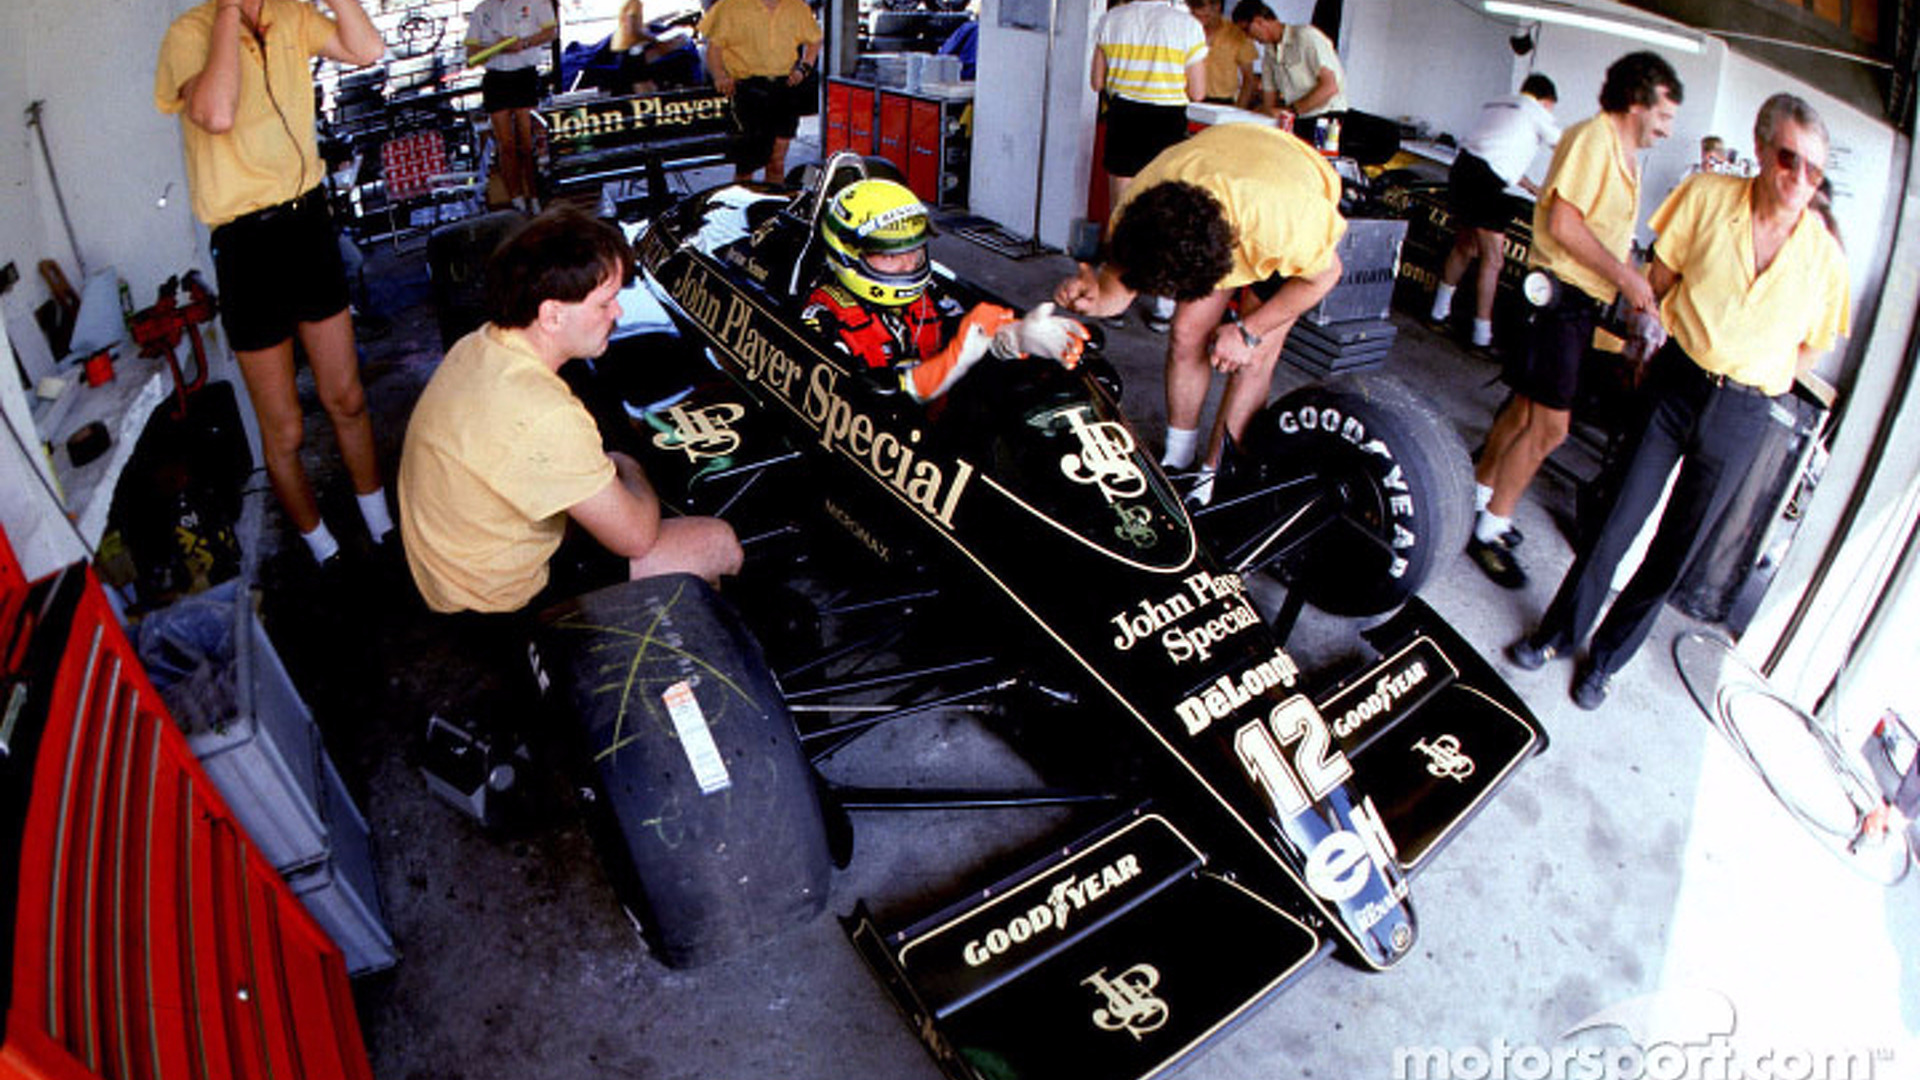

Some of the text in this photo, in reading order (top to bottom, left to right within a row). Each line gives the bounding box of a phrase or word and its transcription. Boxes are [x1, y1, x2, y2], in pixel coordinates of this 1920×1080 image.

[550, 97, 731, 141] John Player
[672, 260, 975, 530] John Player Special
[1110, 594, 1195, 650] John
[1162, 597, 1261, 665] Special
[1333, 661, 1428, 738] GOODYEAR
[1234, 693, 1354, 819] 12
[963, 854, 1142, 967] GOODYEAR
